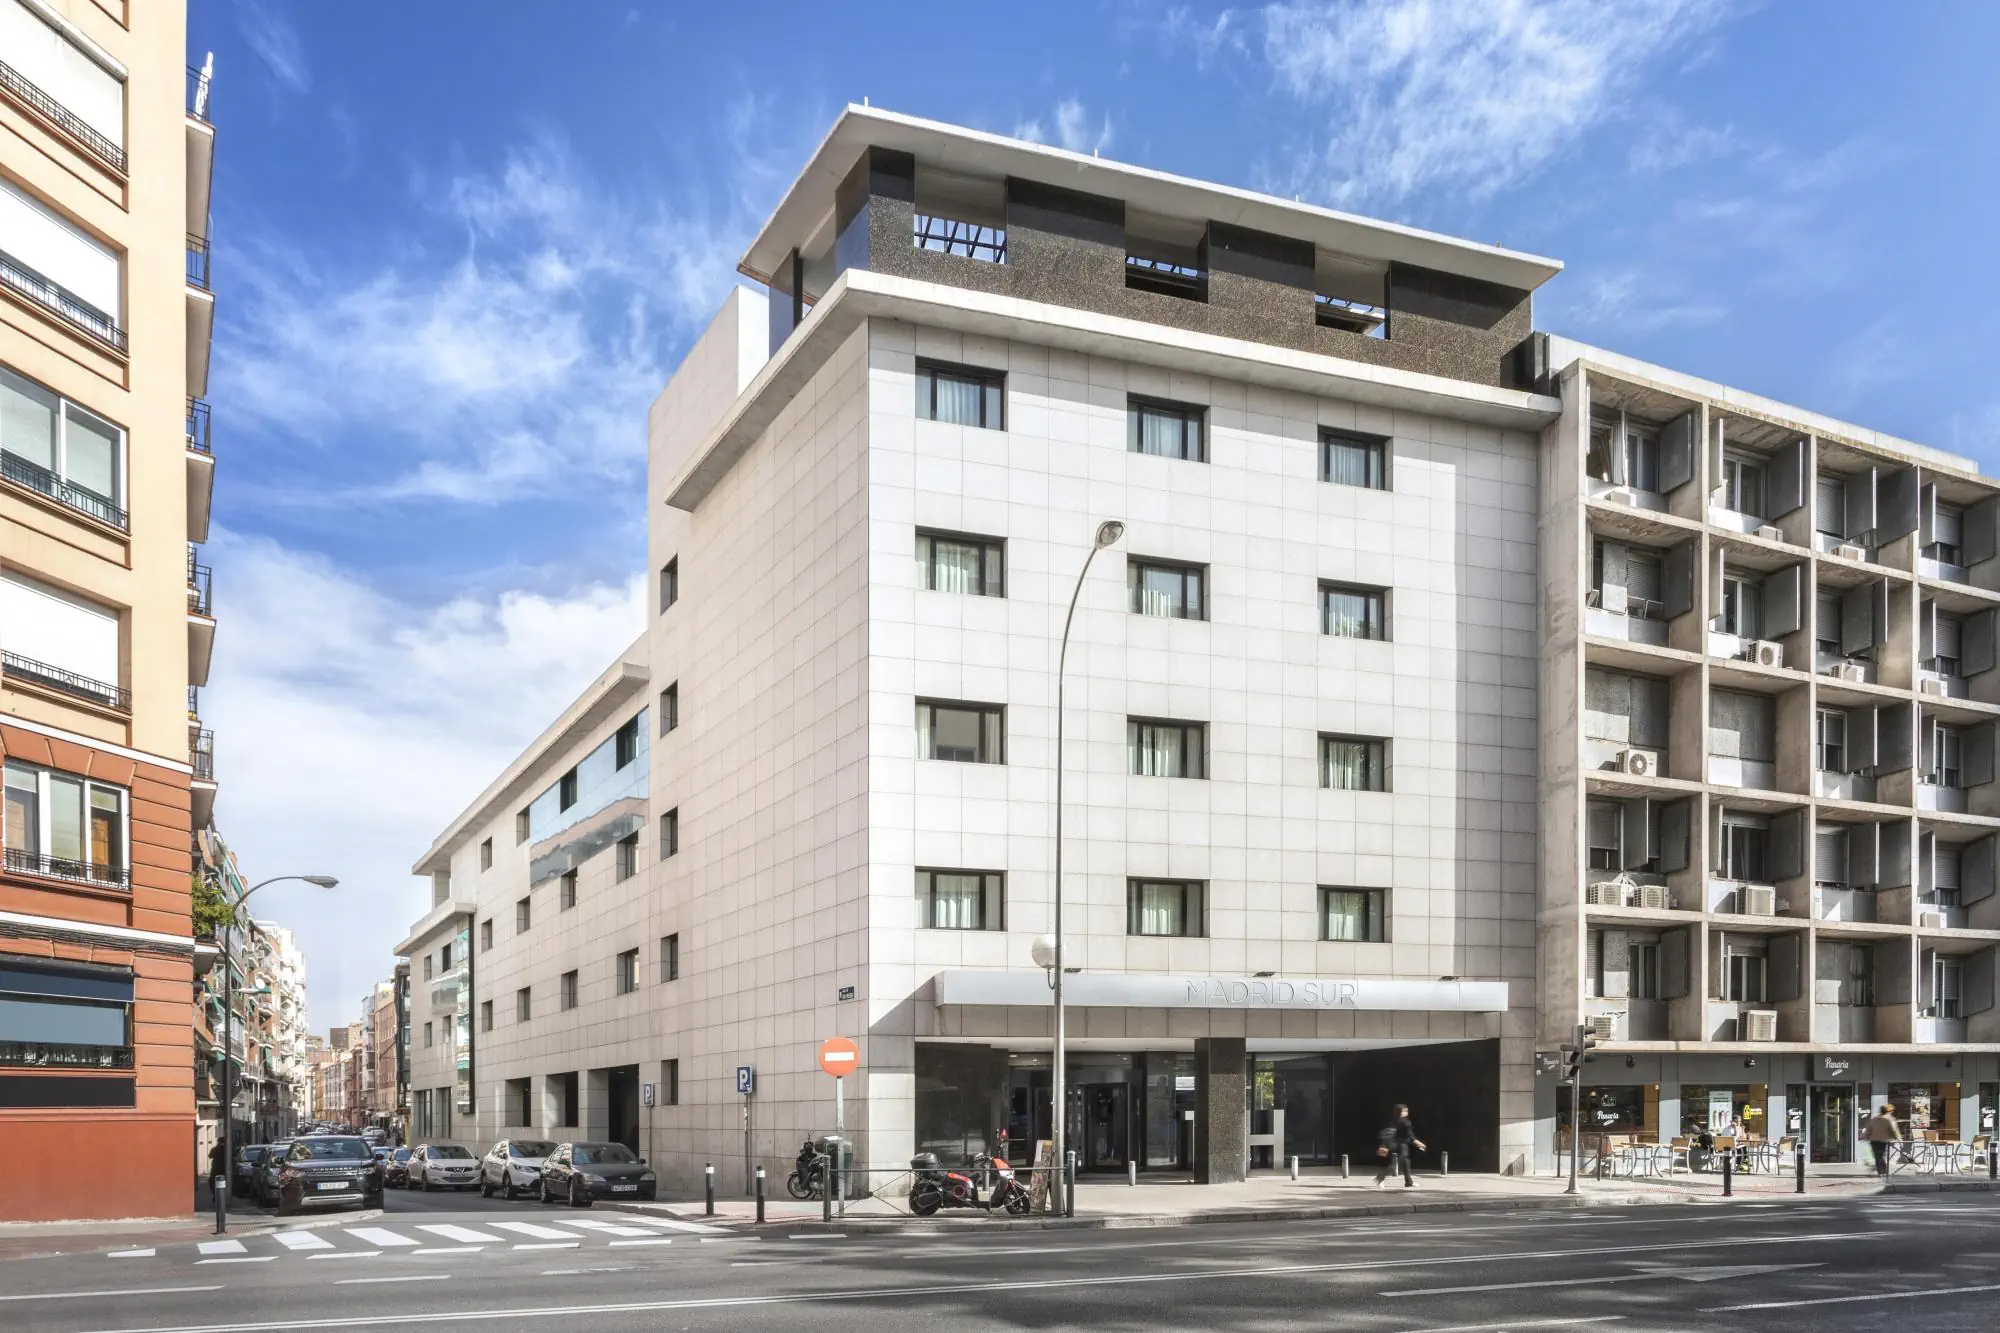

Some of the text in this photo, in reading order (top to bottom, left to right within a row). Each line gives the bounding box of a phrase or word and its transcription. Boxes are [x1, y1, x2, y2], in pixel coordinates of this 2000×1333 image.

[1184, 980, 1356, 1006] MADRID SUR
[1825, 1057, 1849, 1069] Panaria
[1597, 1110, 1619, 1120] Panaria
